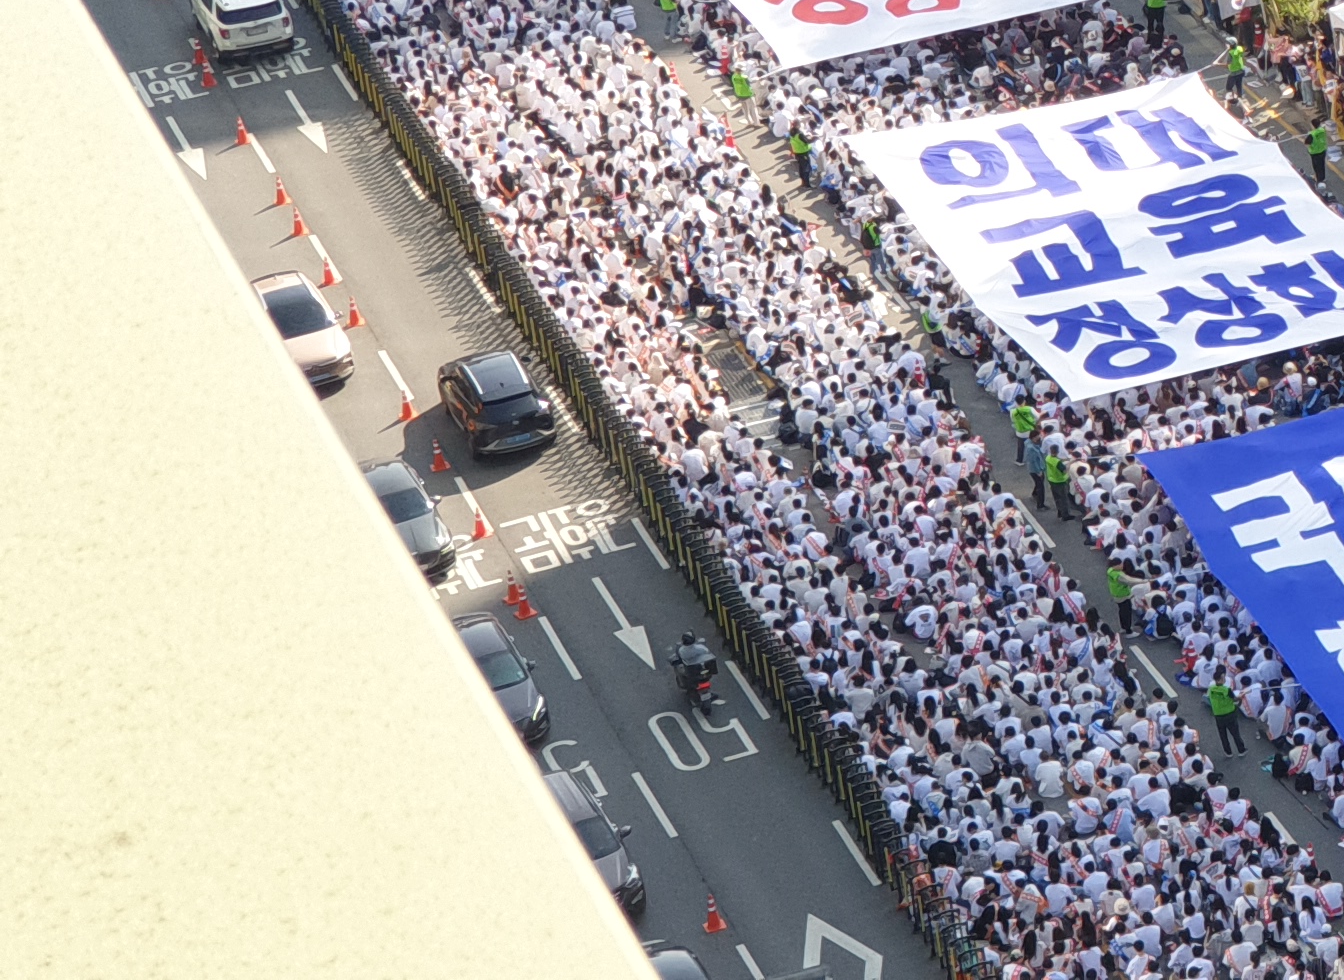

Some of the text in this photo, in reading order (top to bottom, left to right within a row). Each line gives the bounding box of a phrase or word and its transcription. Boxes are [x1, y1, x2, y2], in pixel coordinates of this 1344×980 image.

[918, 106, 1239, 210] 의대
[979, 173, 1306, 298] 교육
[499, 498, 637, 575] 광화문
